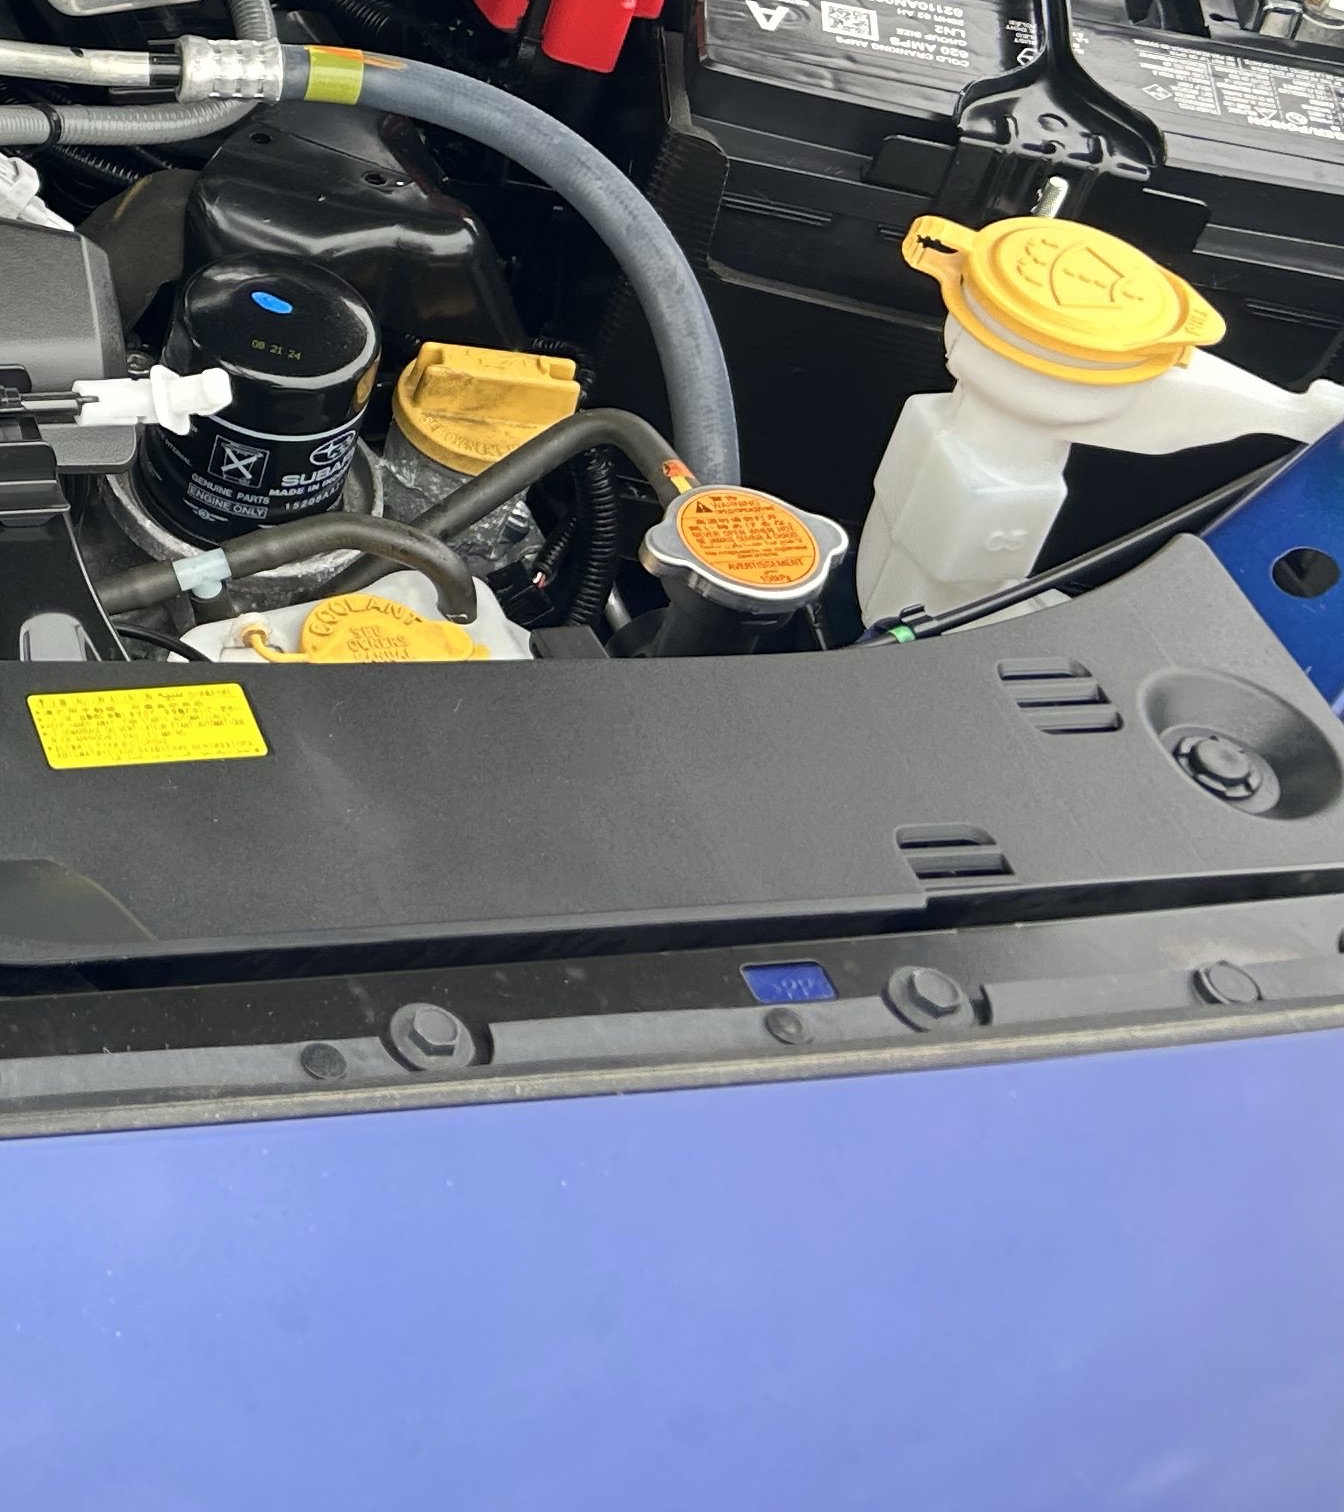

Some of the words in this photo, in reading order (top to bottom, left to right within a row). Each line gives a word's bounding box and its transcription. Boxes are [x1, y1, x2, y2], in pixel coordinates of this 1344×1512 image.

[895, 27, 922, 39] SIZE
[934, 25, 967, 38] LN2
[889, 36, 936, 53] AMPS
[924, 34, 968, 47] GROUP
[871, 41, 934, 61] CRANKING
[940, 46, 969, 58] 620
[935, 55, 970, 67] COLD
[269, 344, 283, 355] 21
[287, 350, 302, 361] 24
[191, 473, 234, 499] GENUINE
[237, 491, 270, 505] PARTS
[269, 487, 305, 497] MADE
[308, 484, 320, 493] IN
[189, 487, 231, 509] ENGINE
[232, 500, 267, 517] ONLY
[309, 597, 424, 637] COOLANT
